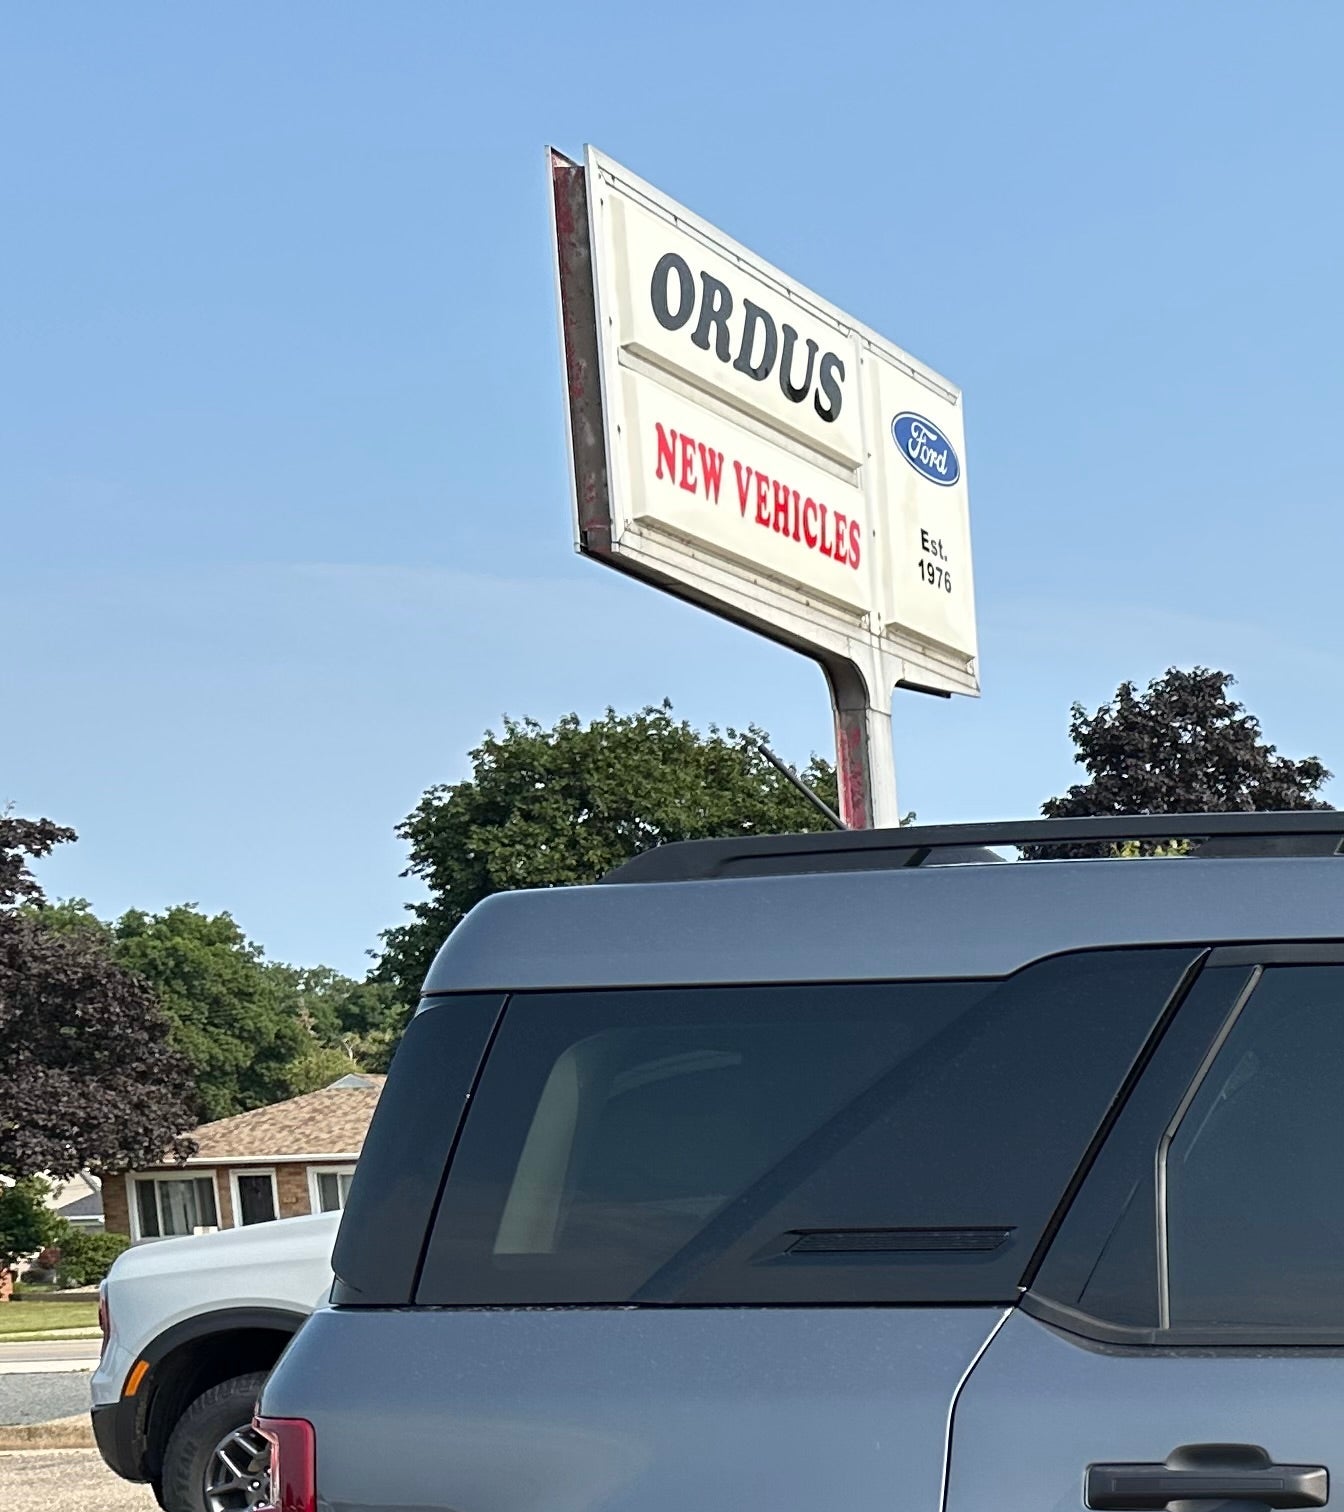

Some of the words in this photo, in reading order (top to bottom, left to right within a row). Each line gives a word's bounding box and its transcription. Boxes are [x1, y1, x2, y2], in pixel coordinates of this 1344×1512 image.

[650, 252, 846, 423] ORDUS
[908, 421, 948, 476] Ford
[655, 422, 725, 506] NEW
[736, 459, 862, 570] VEHICLES
[920, 528, 948, 562] Est.
[918, 558, 951, 594] 1976
